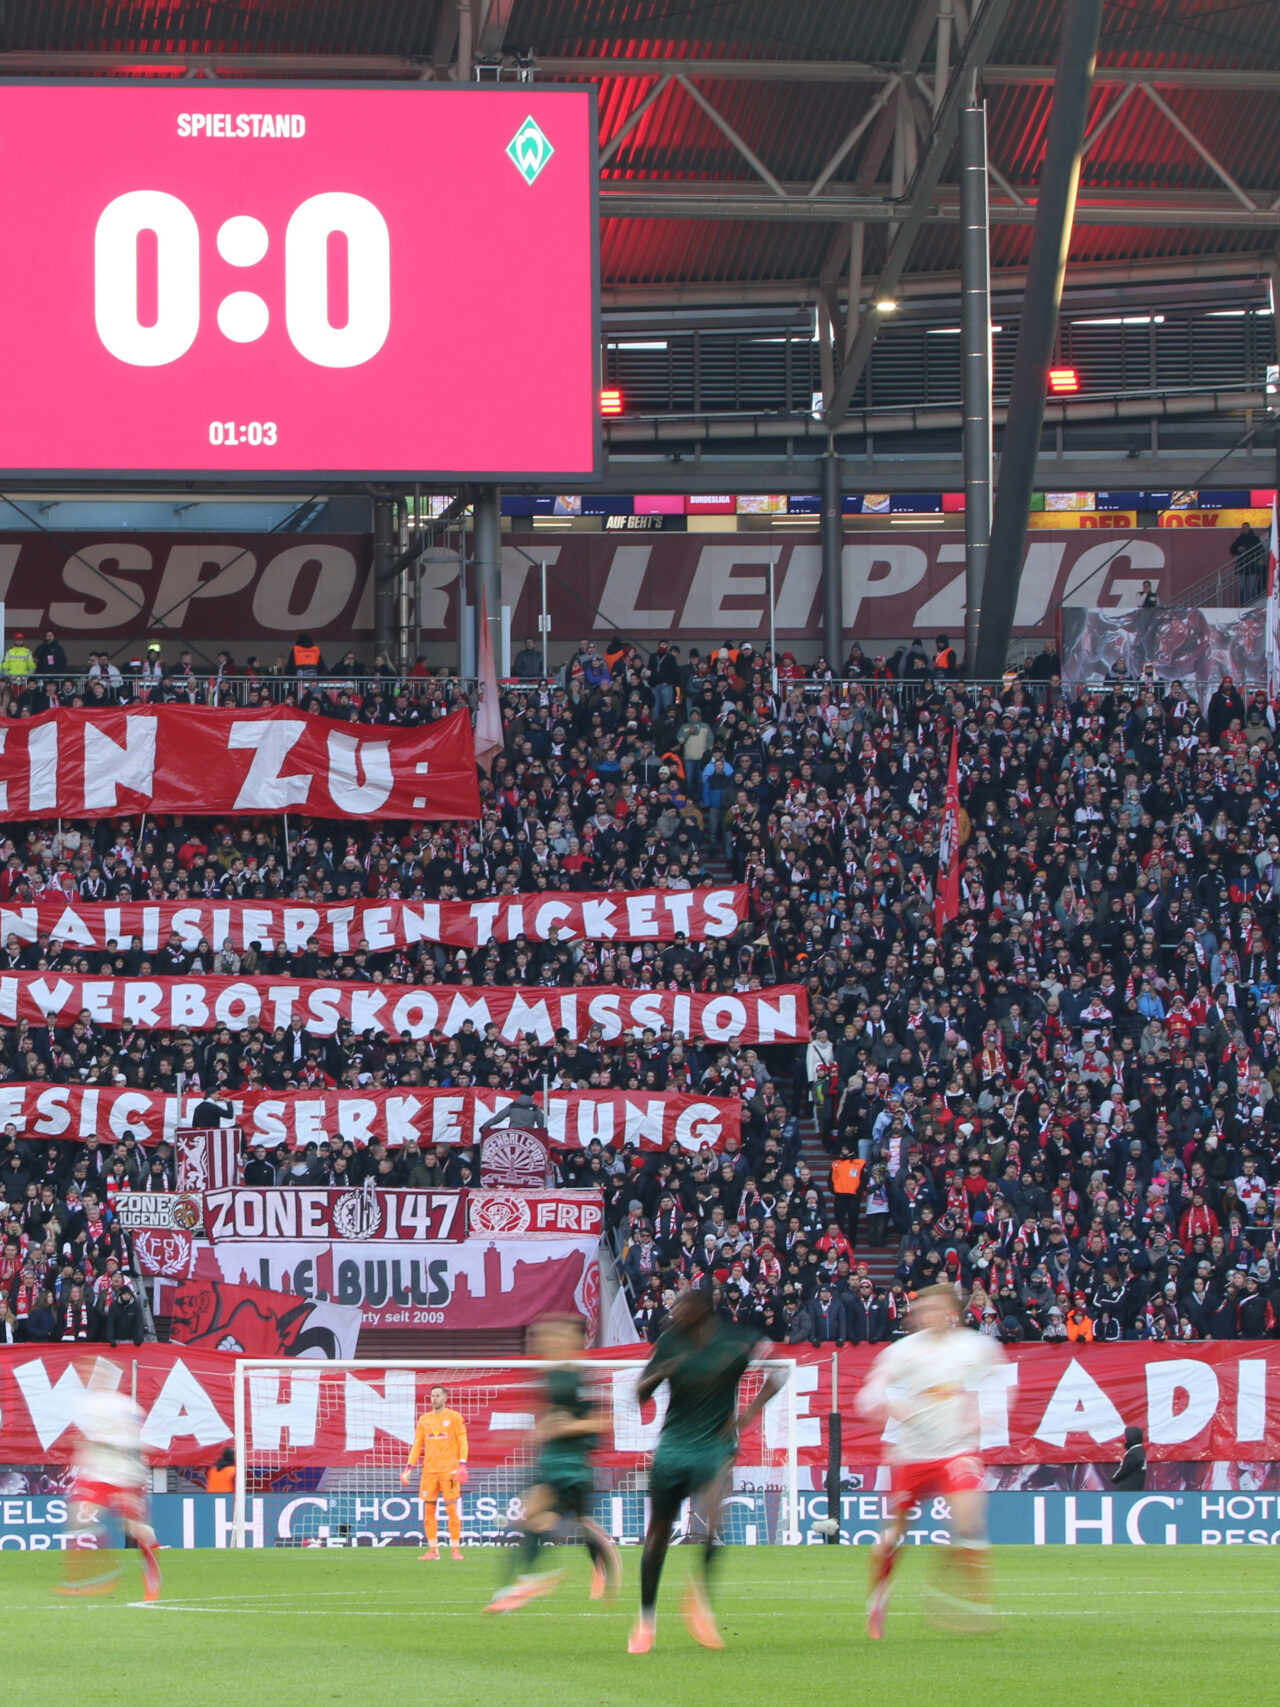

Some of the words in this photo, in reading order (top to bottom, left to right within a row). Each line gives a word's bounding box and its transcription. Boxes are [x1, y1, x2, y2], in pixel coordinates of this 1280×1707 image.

[176, 112, 306, 139] SPIELSTAND
[93, 189, 391, 369] 0:0
[208, 420, 278, 446] 01:03
[606, 515, 628, 529] AUF
[627, 515, 664, 529] GEHT'S
[226, 719, 428, 815] ZU:
[469, 889, 739, 946] TICKETS
[114, 1195, 171, 1213] ZONE
[205, 1190, 329, 1238] ZONE
[384, 1193, 461, 1240] 147
[536, 1202, 602, 1231] FRP
[337, 1258, 452, 1308] BULLS
[384, 1310, 411, 1324] seit
[412, 1311, 445, 1325] 2009
[75, 1499, 100, 1525] &
[355, 1497, 498, 1522] HOTELS
[506, 1497, 527, 1522] &
[930, 1496, 953, 1521] &
[1034, 1495, 1177, 1545] IHG
